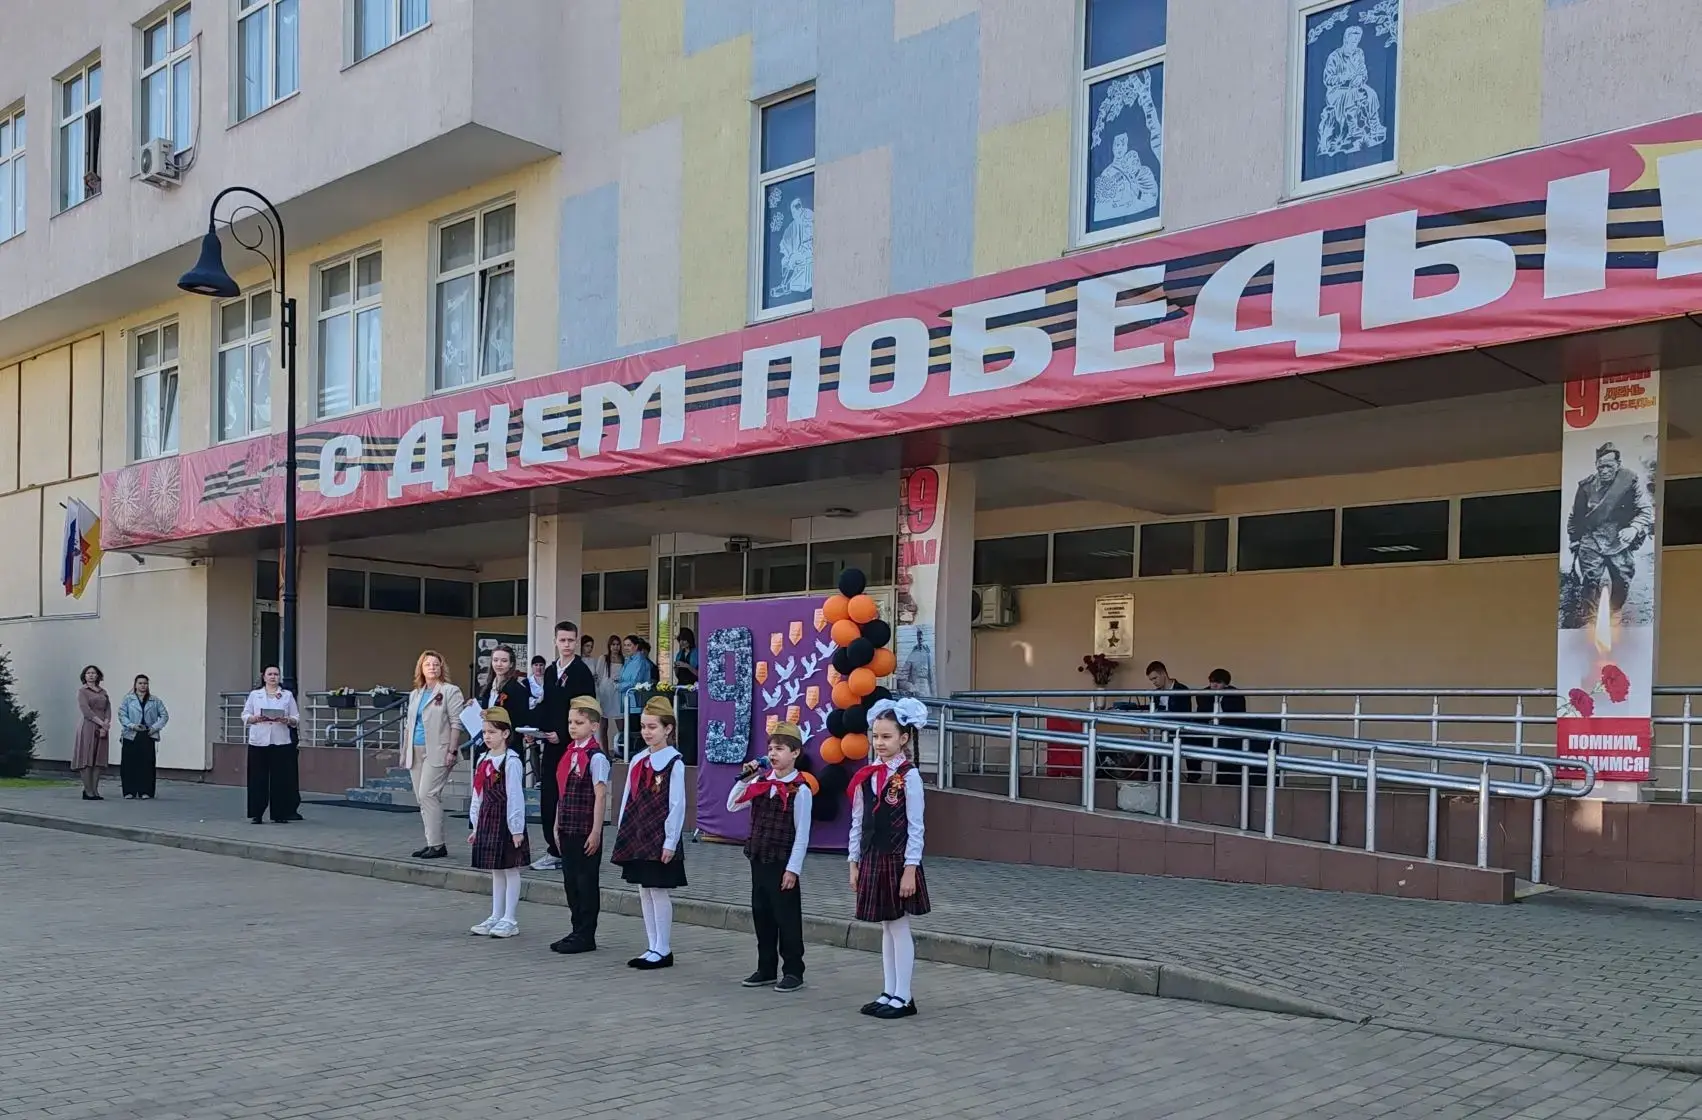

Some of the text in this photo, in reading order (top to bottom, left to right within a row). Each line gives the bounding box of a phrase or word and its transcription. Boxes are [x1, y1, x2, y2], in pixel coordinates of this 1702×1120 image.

[1602, 396, 1657, 412] ПОБЕДЫ
[1604, 384, 1646, 401] ДЕНЬ
[319, 435, 362, 498] С
[387, 365, 686, 498] ДНЕМ
[907, 467, 939, 534] 9
[705, 627, 753, 764] 9
[1568, 734, 1642, 752] ПОМНИМ,
